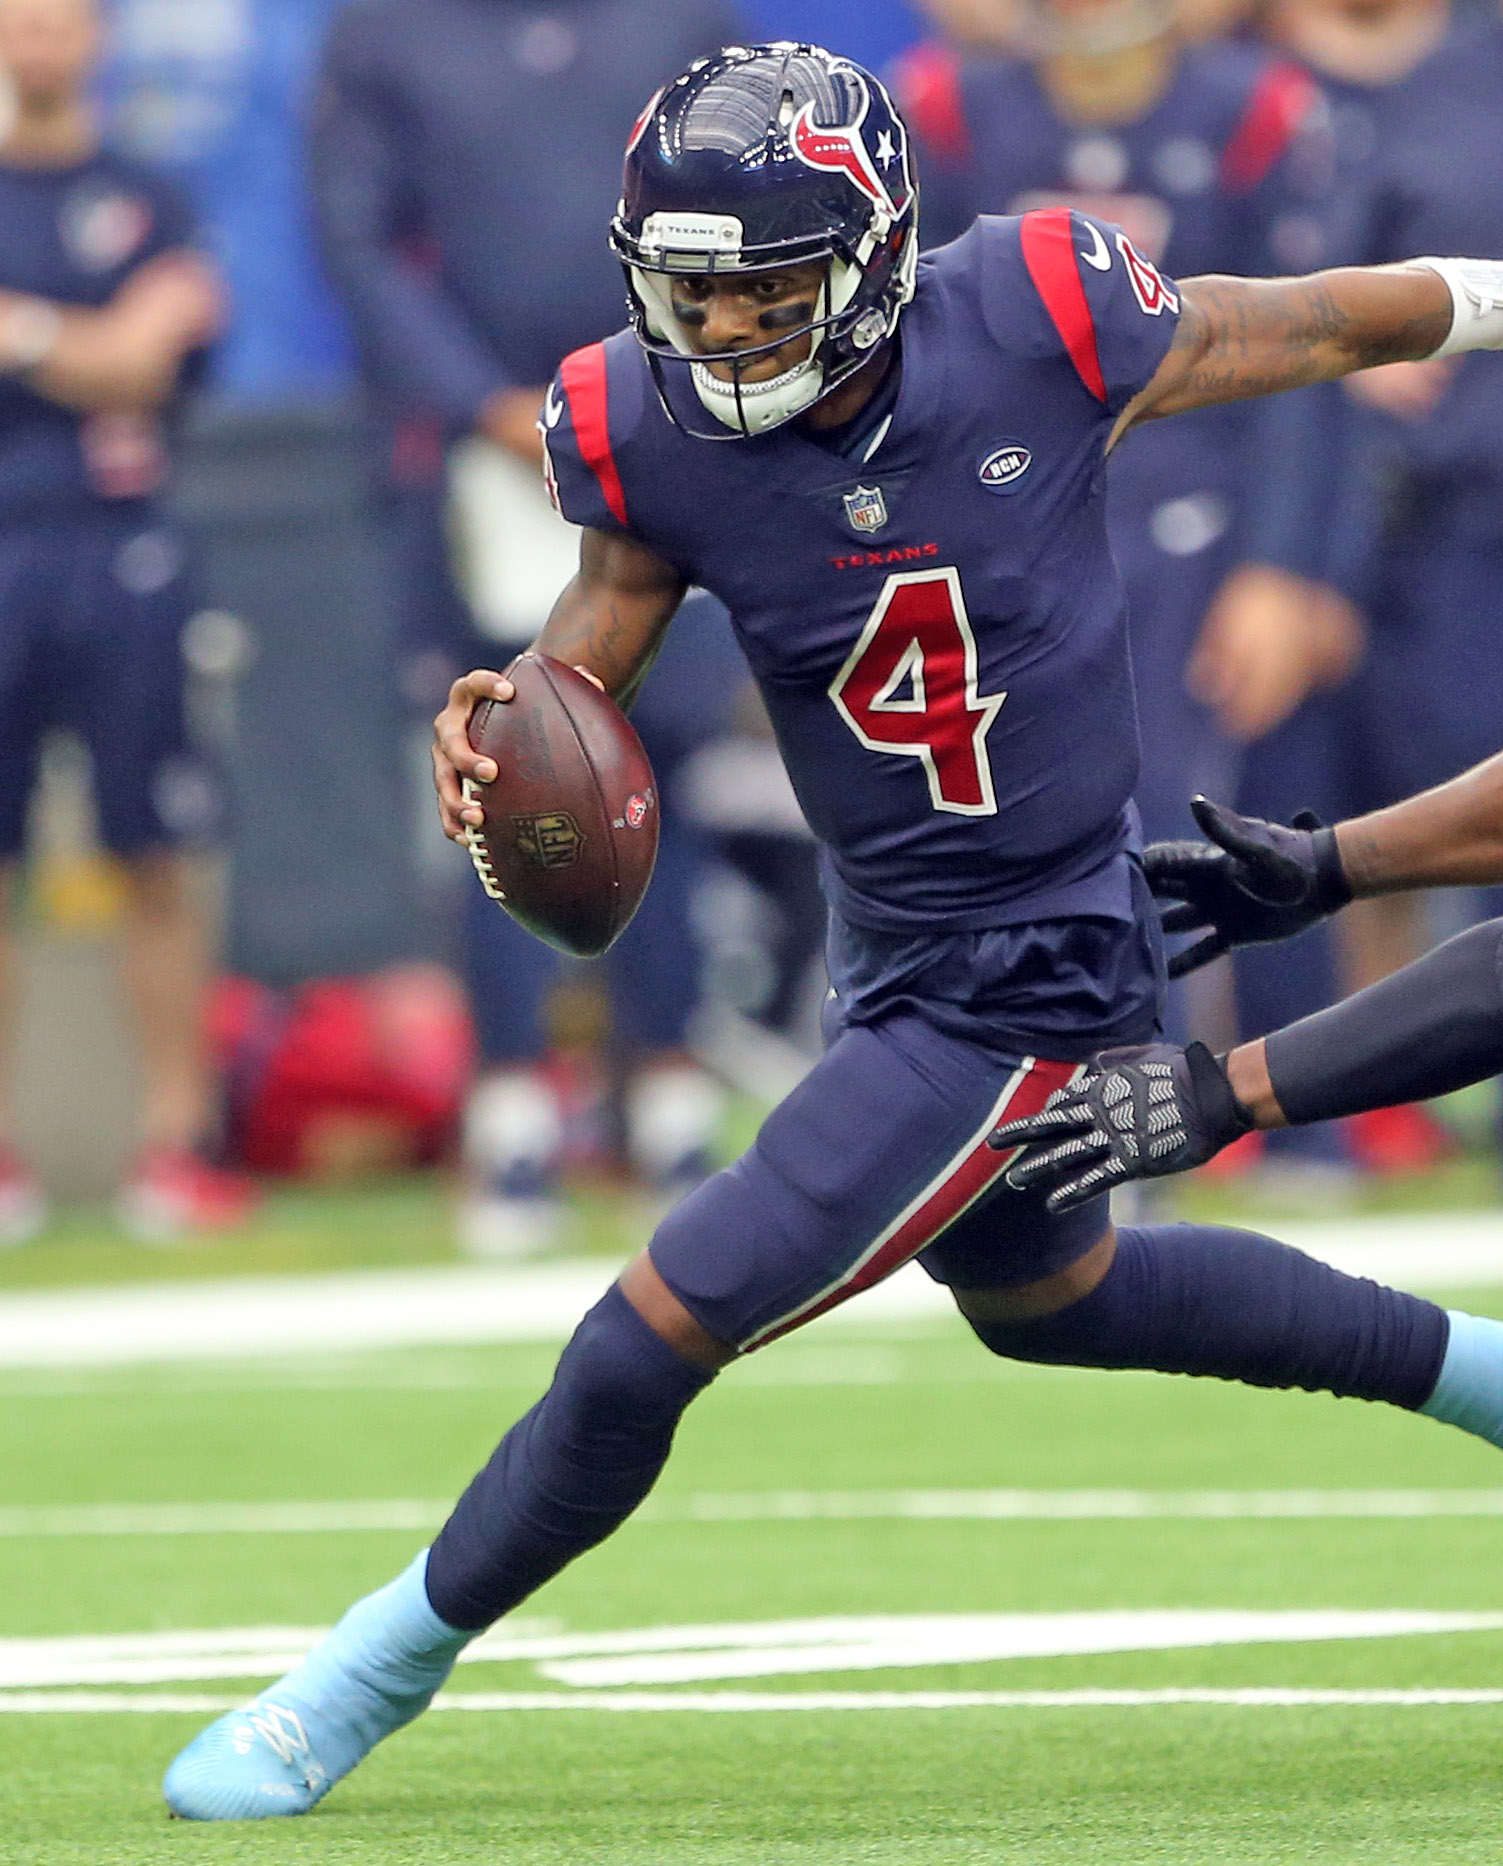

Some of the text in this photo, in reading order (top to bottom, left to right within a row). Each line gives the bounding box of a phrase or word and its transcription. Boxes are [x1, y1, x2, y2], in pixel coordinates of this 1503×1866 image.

[667, 226, 715, 235] TEXANS
[1115, 231, 1180, 316] 4
[854, 504, 883, 527] NFL
[829, 543, 938, 569] TEXANS
[827, 566, 1008, 816] 4
